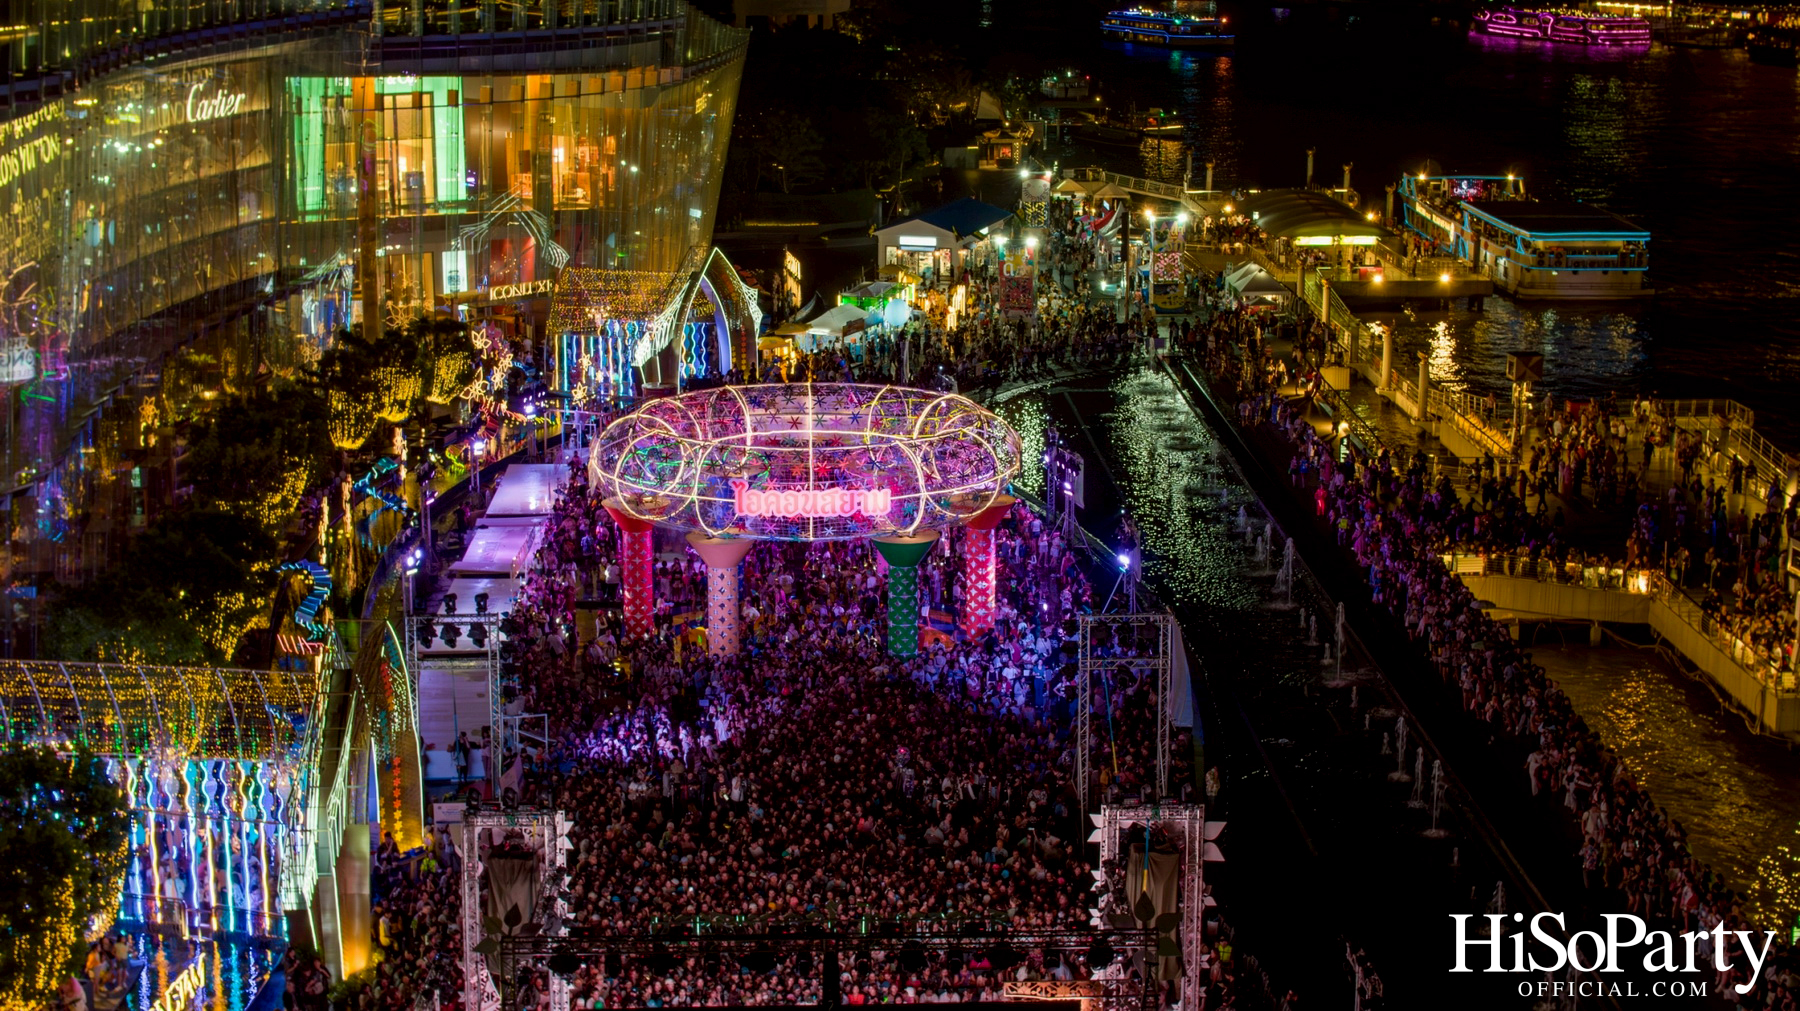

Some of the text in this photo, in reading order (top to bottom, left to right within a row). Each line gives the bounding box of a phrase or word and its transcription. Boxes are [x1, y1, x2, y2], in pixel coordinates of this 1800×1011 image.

[186, 82, 246, 123] Cartier
[730, 480, 891, 516] ไอคอนสยาม
